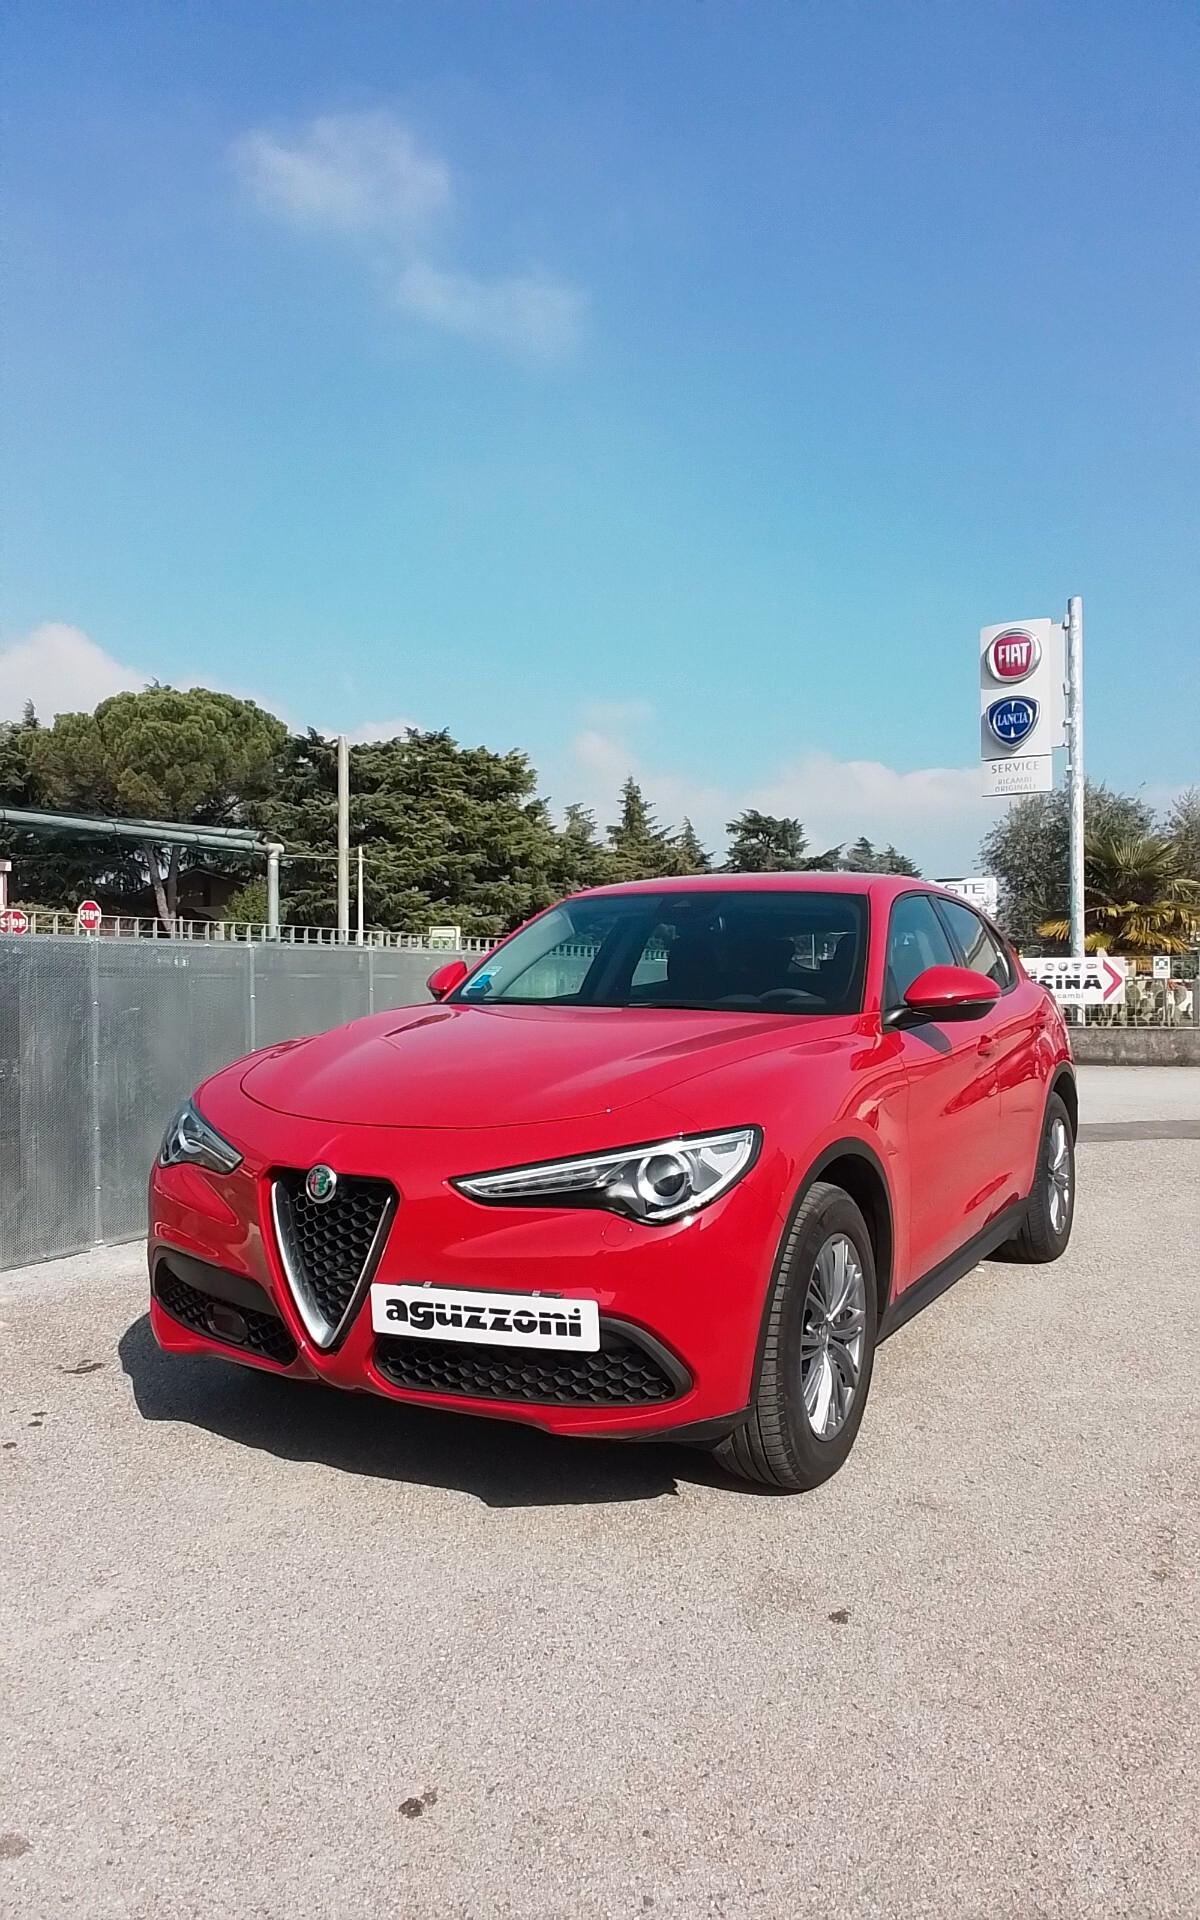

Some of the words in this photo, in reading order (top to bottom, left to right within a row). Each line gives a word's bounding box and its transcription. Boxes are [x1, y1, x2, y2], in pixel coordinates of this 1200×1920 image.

[998, 642, 1030, 669] FIAT
[997, 712, 1028, 726] LANCIA
[991, 761, 1039, 774] SERVICE
[995, 784, 1036, 793] ORIGINALI
[80, 910, 100, 920] STOP
[0, 918, 26, 928] SOP
[386, 1299, 581, 1337] aguzzoni
